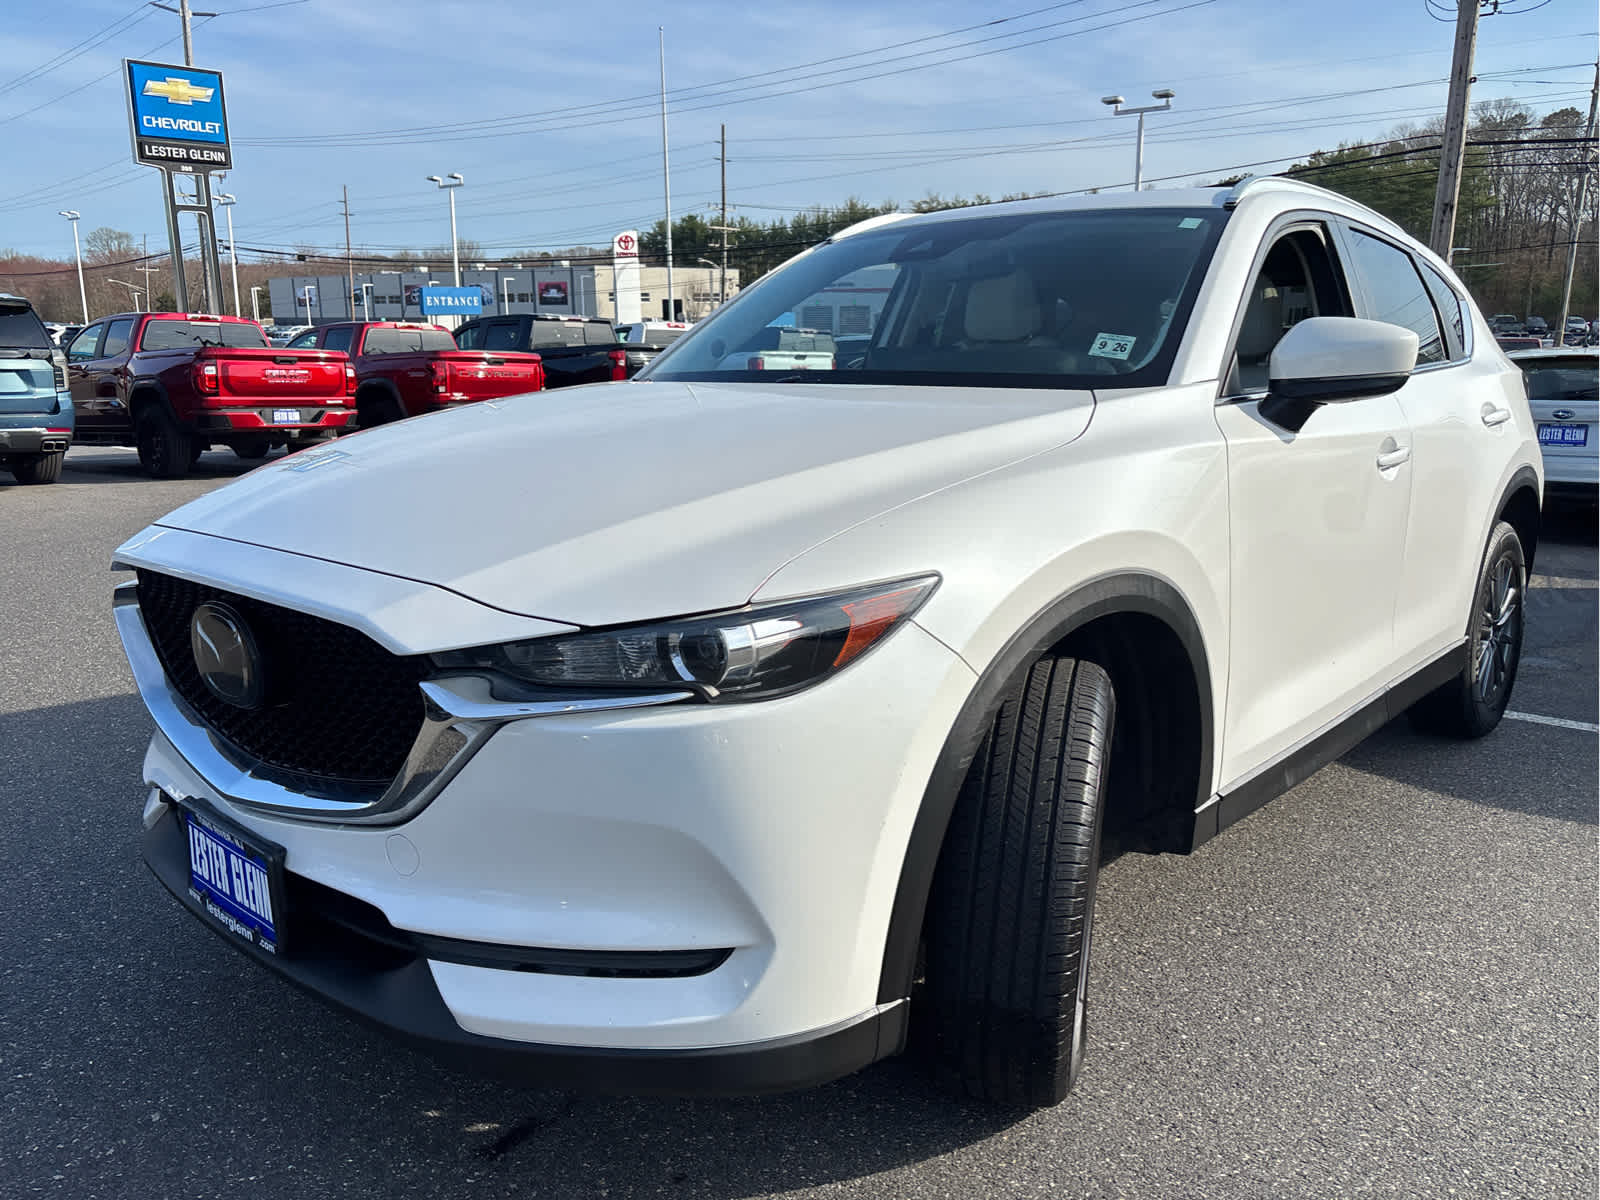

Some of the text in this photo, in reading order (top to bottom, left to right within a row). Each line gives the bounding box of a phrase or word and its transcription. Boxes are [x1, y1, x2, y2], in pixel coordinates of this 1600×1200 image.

[142, 115, 221, 134] CHEVROLET
[144, 144, 226, 162] LESTER GLENN
[426, 296, 480, 306] ENTRANCE
[1098, 340, 1128, 353] 9 26
[1539, 427, 1562, 440] LESTER
[187, 824, 274, 925] LESTER GLENN
